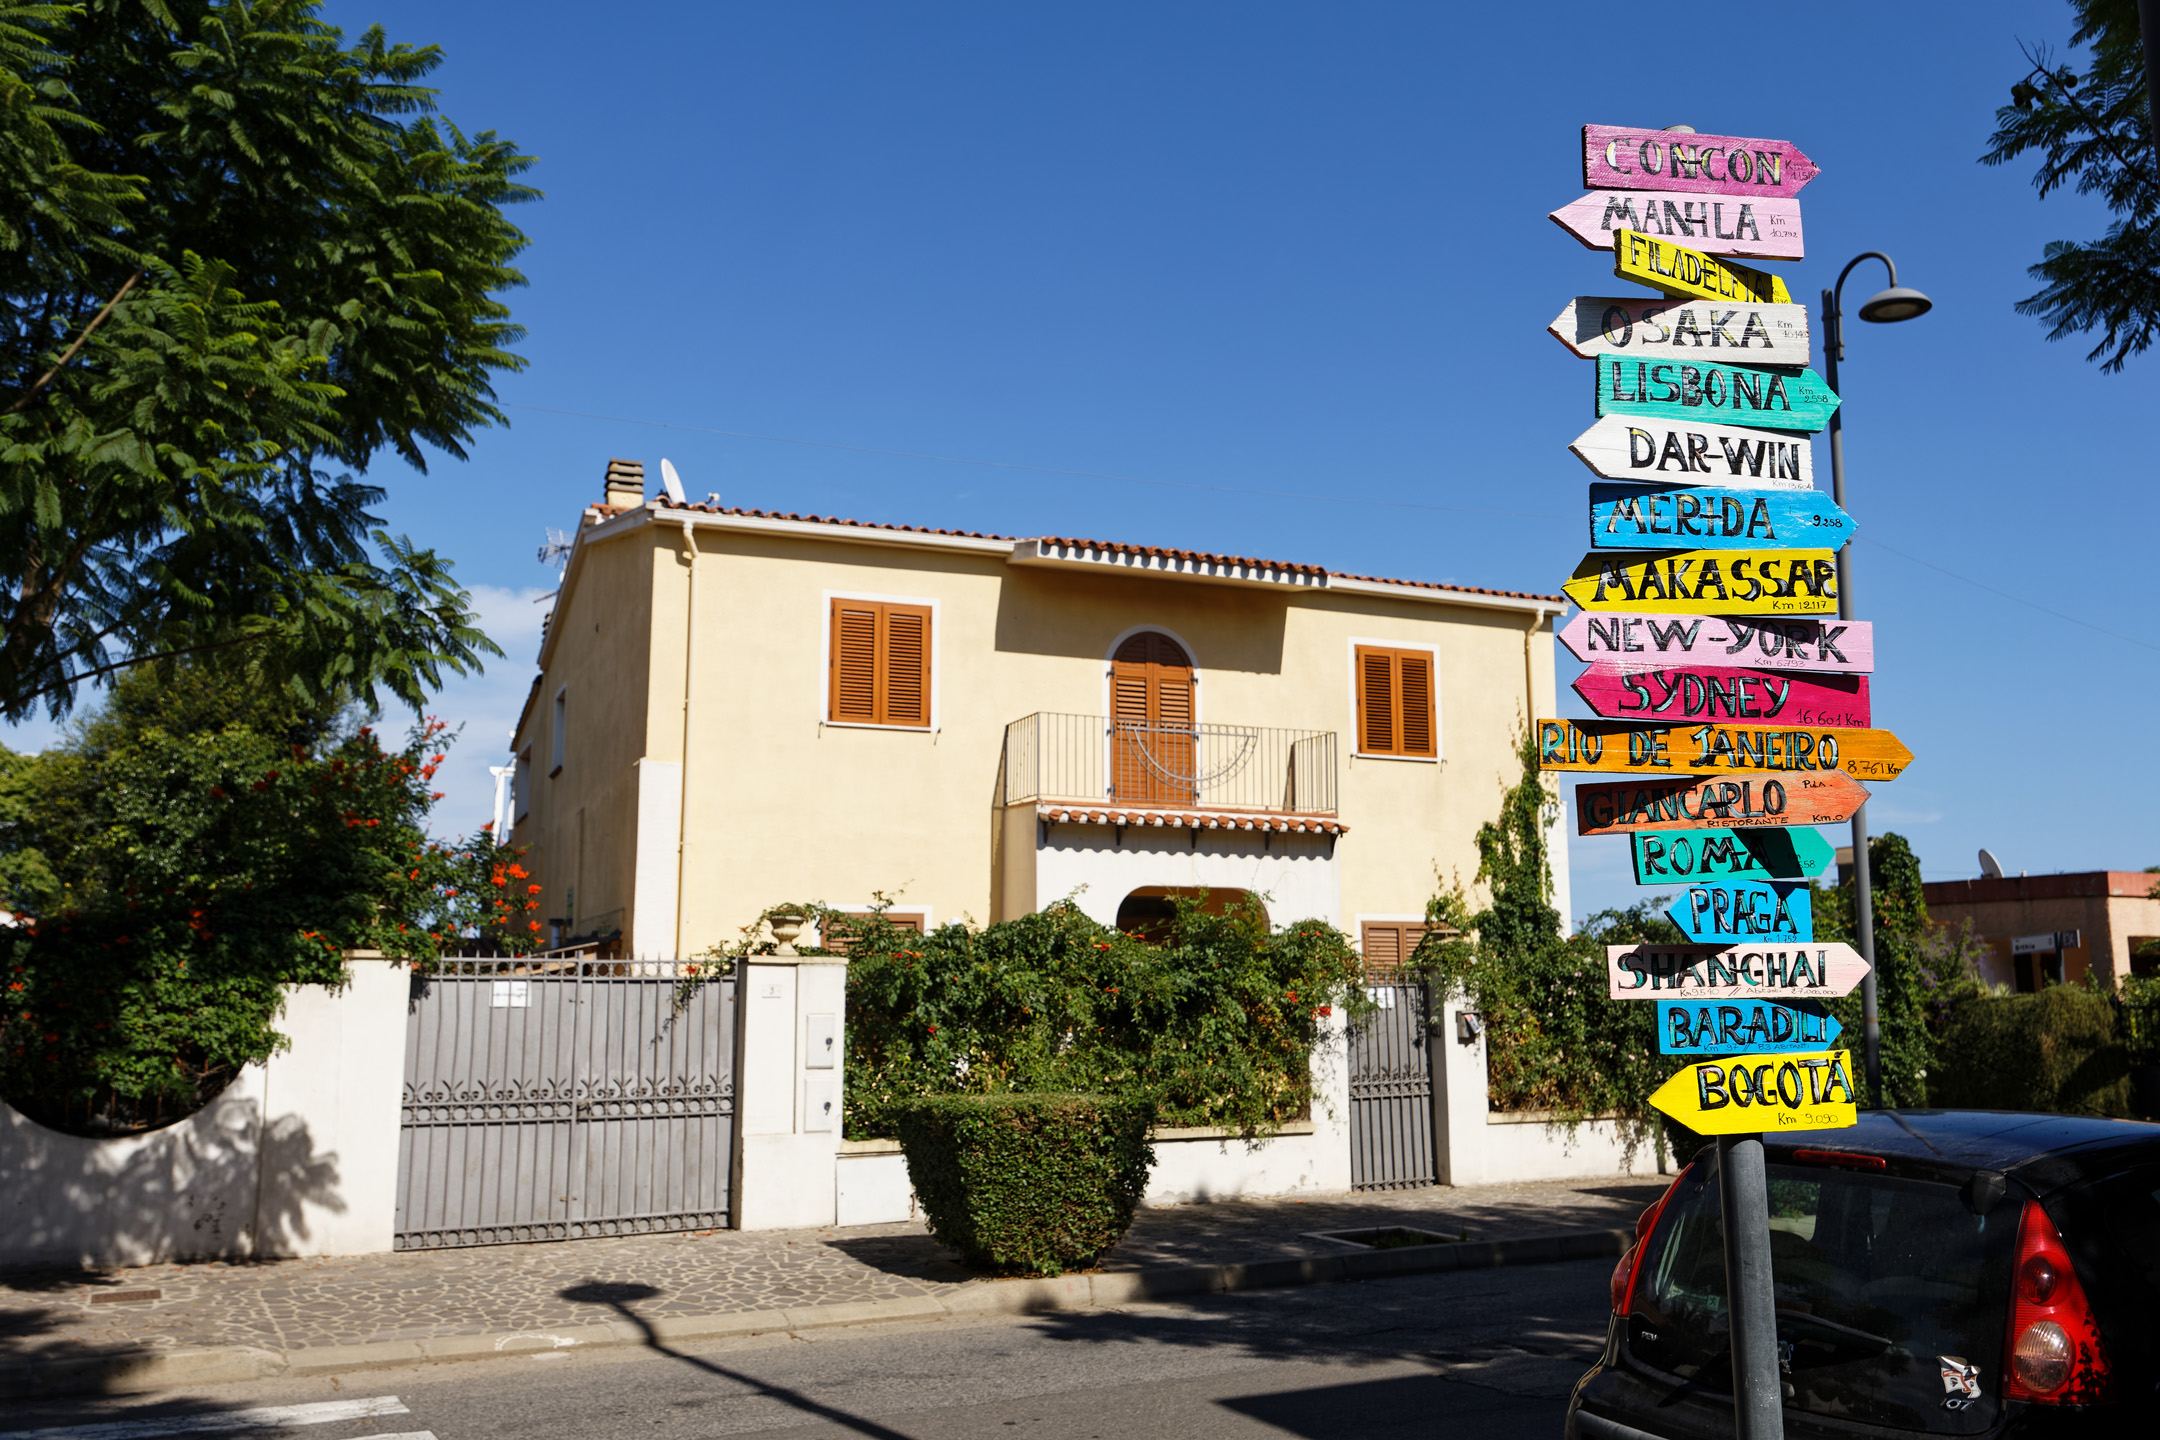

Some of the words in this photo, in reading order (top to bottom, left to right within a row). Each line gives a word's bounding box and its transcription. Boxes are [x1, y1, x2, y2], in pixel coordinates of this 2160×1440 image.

[1605, 137, 1783, 186] CONCON
[1600, 196, 1763, 241] MANILA
[1770, 215, 1785, 225] Km
[1630, 234, 1767, 302] FILADELFIA
[1602, 305, 1774, 348] OSAKA
[1777, 320, 1793, 329] Km
[1610, 361, 1792, 411] LISBONA
[1798, 386, 1814, 395] Km
[1772, 480, 1786, 488] Km
[1813, 514, 1843, 528] 9.258
[1590, 556, 1838, 602] MAKASSAR
[1773, 600, 1794, 610] Km
[1755, 657, 1772, 666] Km
[1619, 671, 1791, 718] SYDNEY
[1795, 708, 1841, 725] 16.601
[1845, 713, 1864, 727] Km
[1542, 722, 1603, 765] RIO
[1628, 727, 1674, 768] DE
[1689, 724, 1839, 771] JANEIRO
[1847, 760, 1884, 775] 8.761
[1887, 763, 1903, 775] Km
[1583, 779, 1787, 828] GIANCARLO
[1707, 816, 1788, 828] RISTORANTE
[1640, 835, 1775, 876] ROMA
[1690, 888, 1800, 935] PRAGA
[1617, 950, 1829, 991] SHANGHAI
[1667, 1005, 1829, 1048] BARADILI
[1704, 1044, 1719, 1052] Km
[1778, 1112, 1797, 1125] Km
